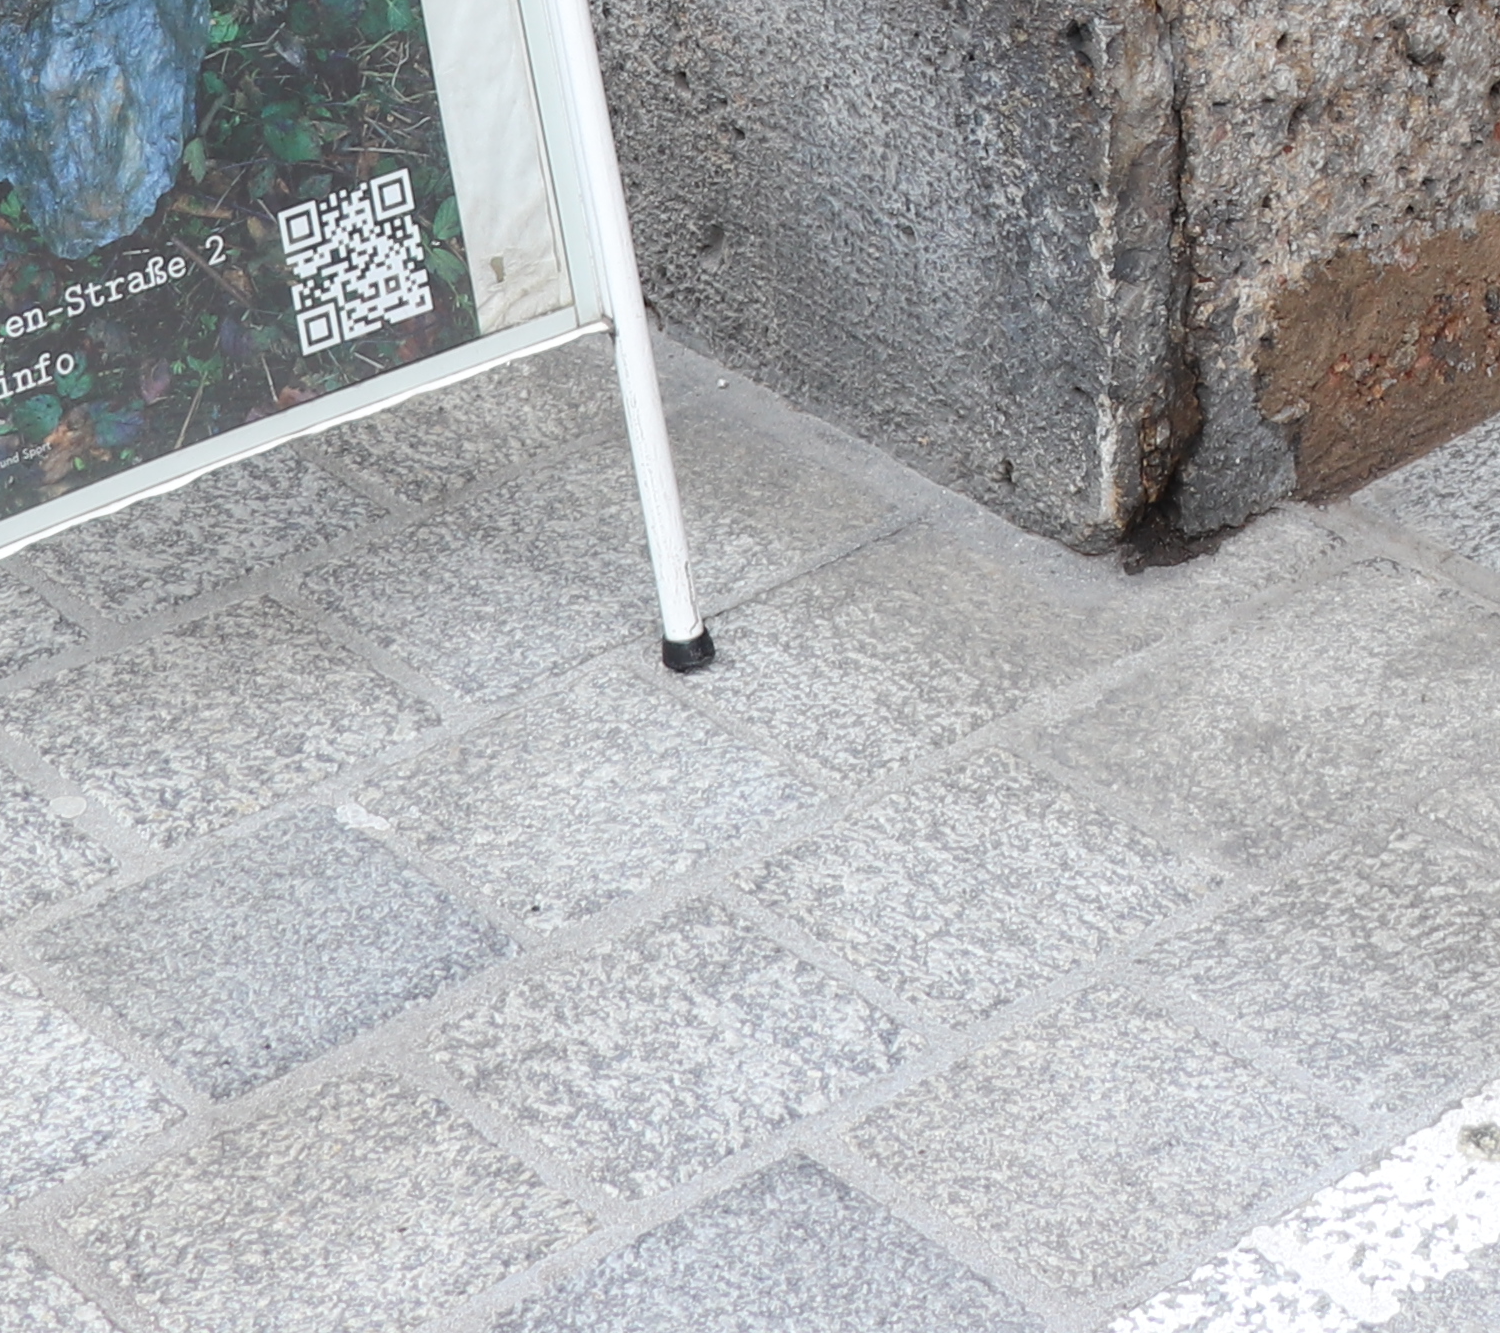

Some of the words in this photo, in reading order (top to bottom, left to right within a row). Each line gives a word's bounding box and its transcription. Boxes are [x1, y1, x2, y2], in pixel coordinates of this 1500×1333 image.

[204, 234, 229, 266] 2
[0, 451, 21, 470] und
[22, 441, 52, 464] Sport
